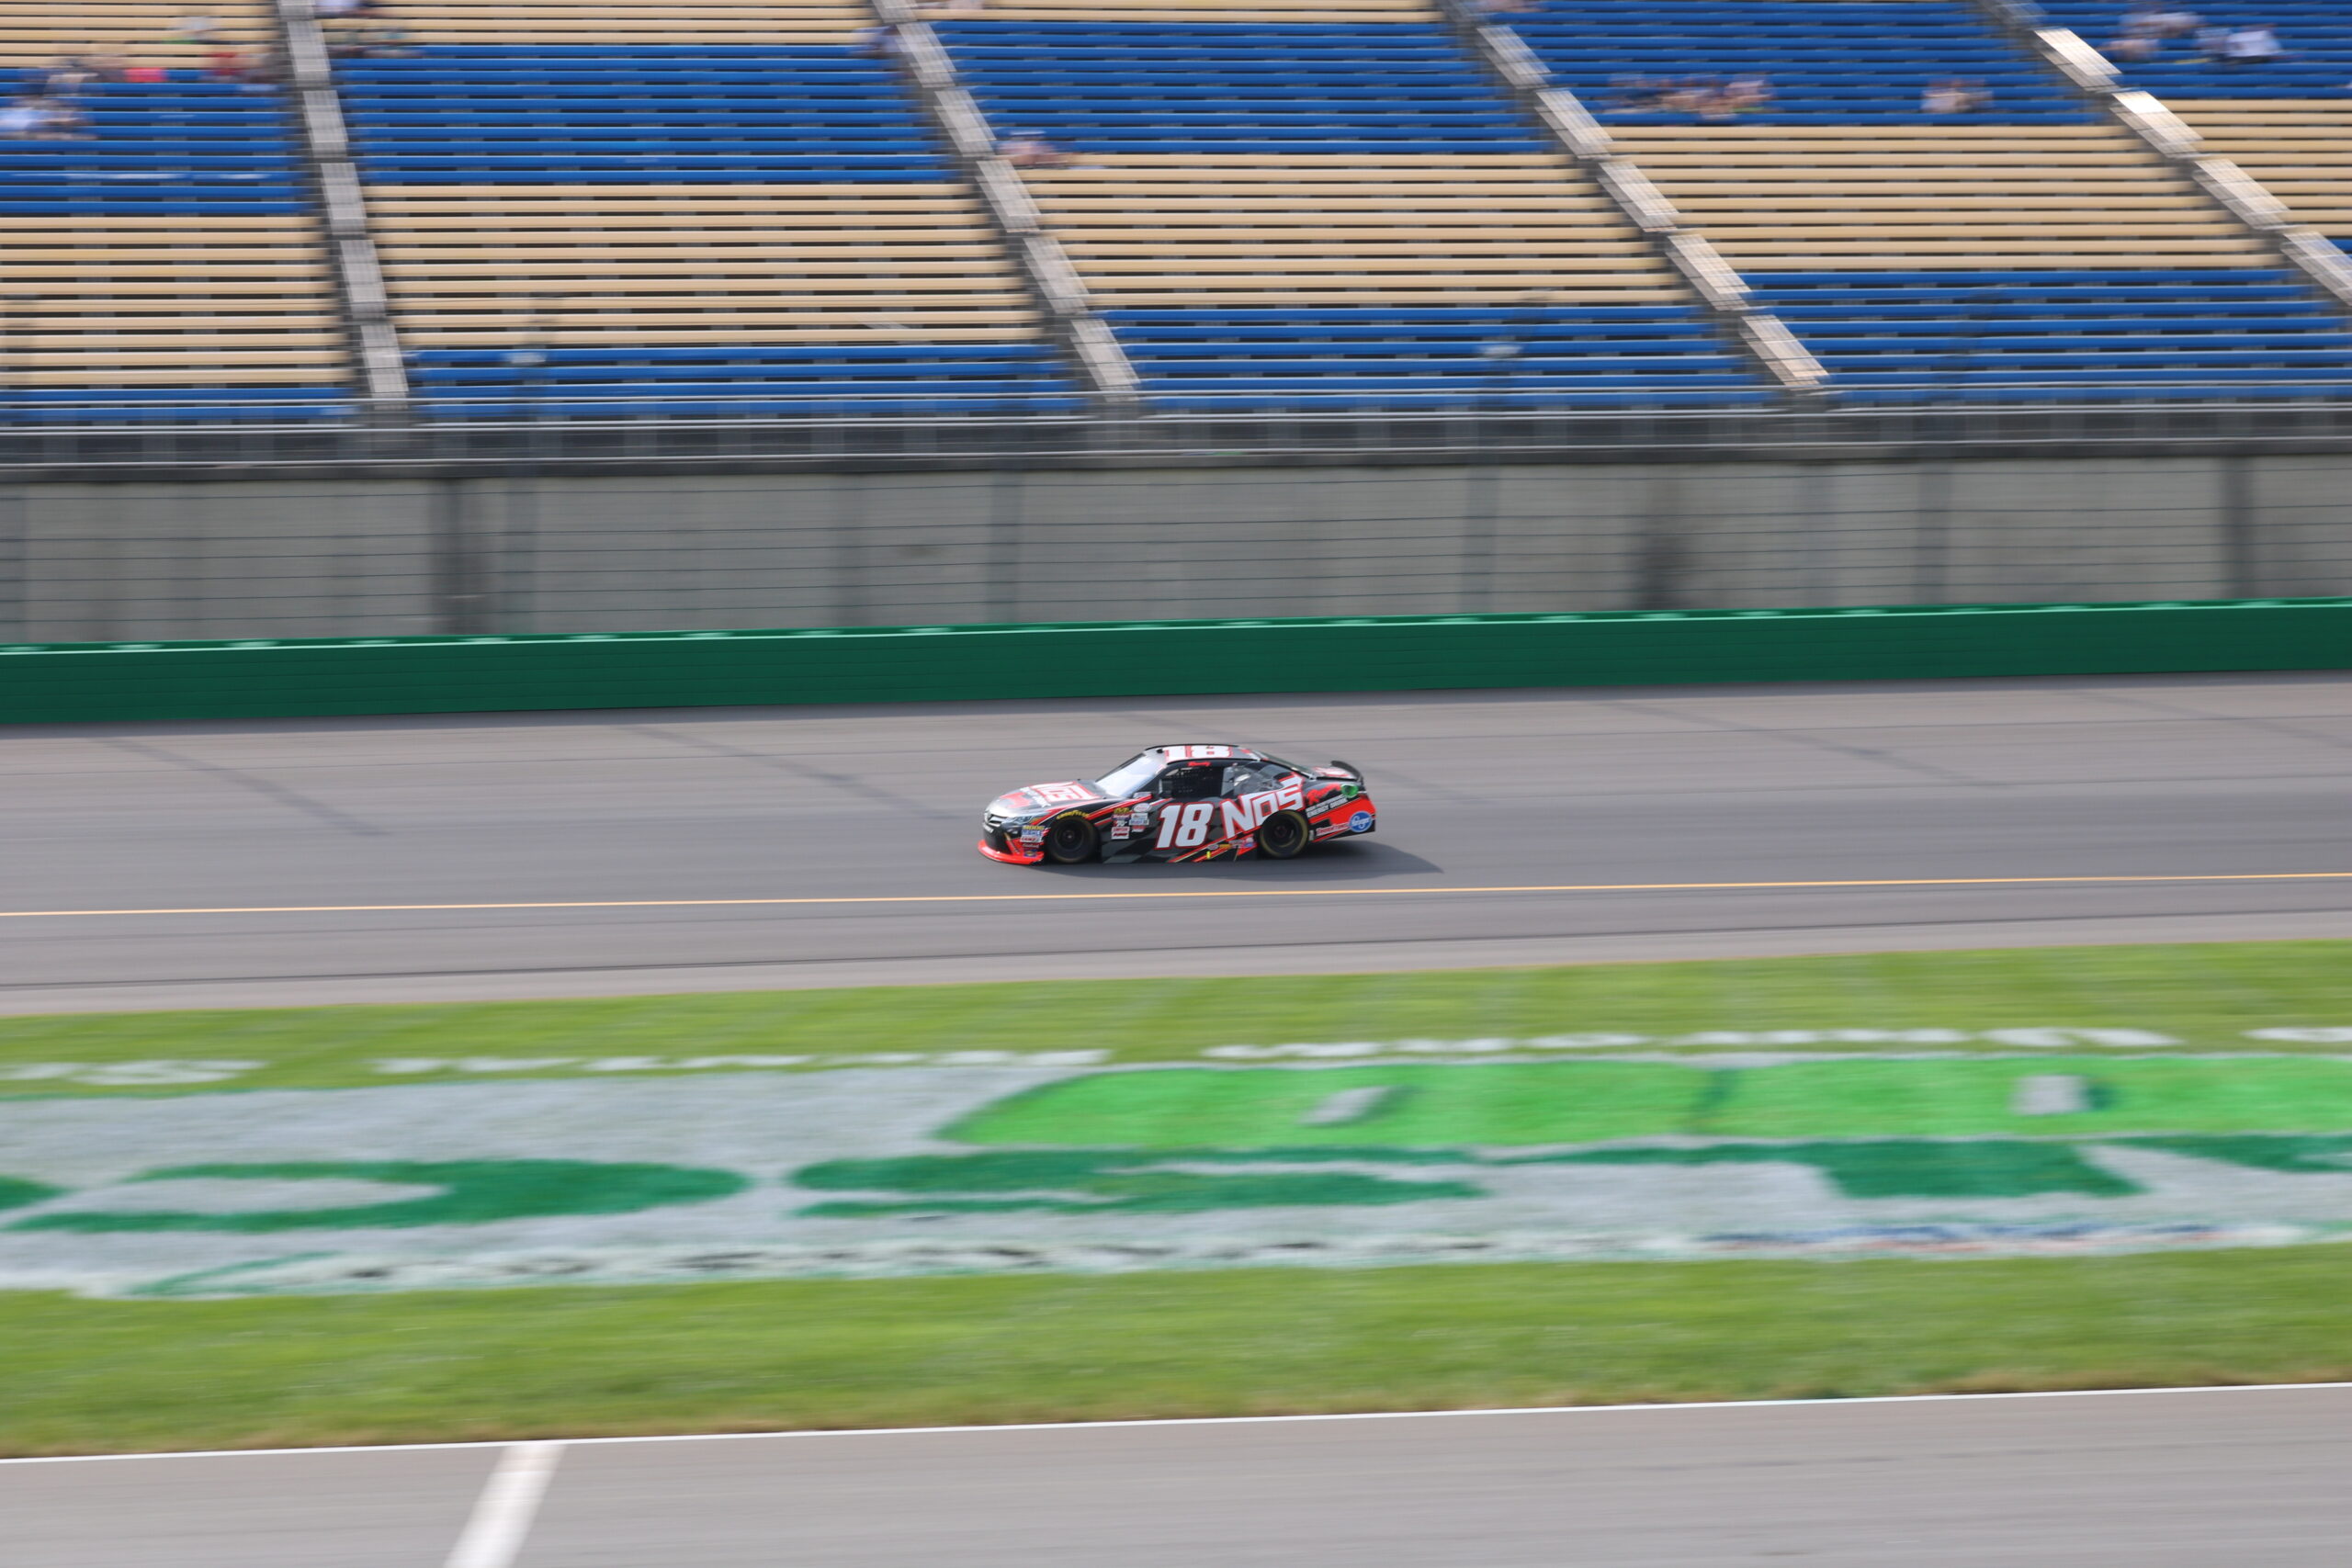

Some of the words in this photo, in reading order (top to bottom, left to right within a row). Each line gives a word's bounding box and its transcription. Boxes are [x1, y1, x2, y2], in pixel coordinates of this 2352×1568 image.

[1164, 745, 1232, 762] 18
[1155, 802, 1214, 849] 18
[1221, 773, 1305, 840] NOS
